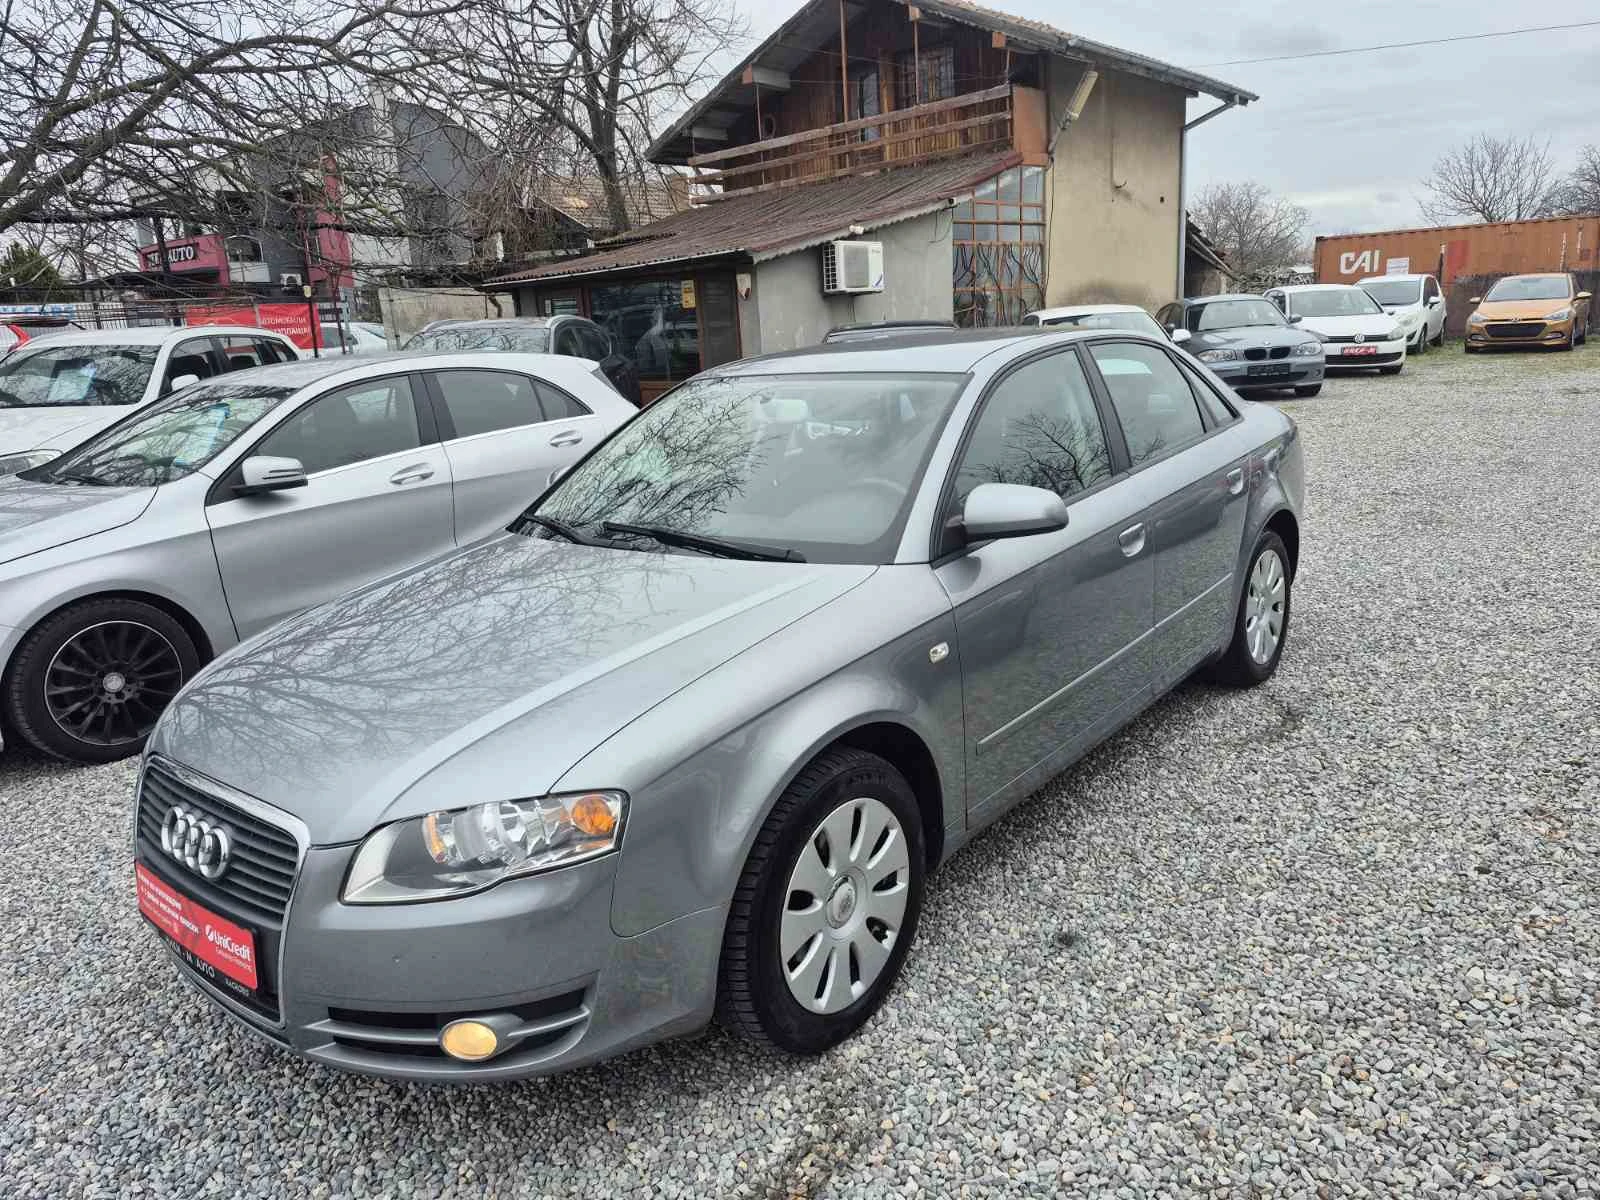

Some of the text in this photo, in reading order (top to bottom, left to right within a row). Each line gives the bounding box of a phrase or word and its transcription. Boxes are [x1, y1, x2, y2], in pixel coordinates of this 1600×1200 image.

[168, 246, 194, 262] AUTO
[1340, 249, 1380, 274] CAI
[214, 929, 250, 961] UniCredit
